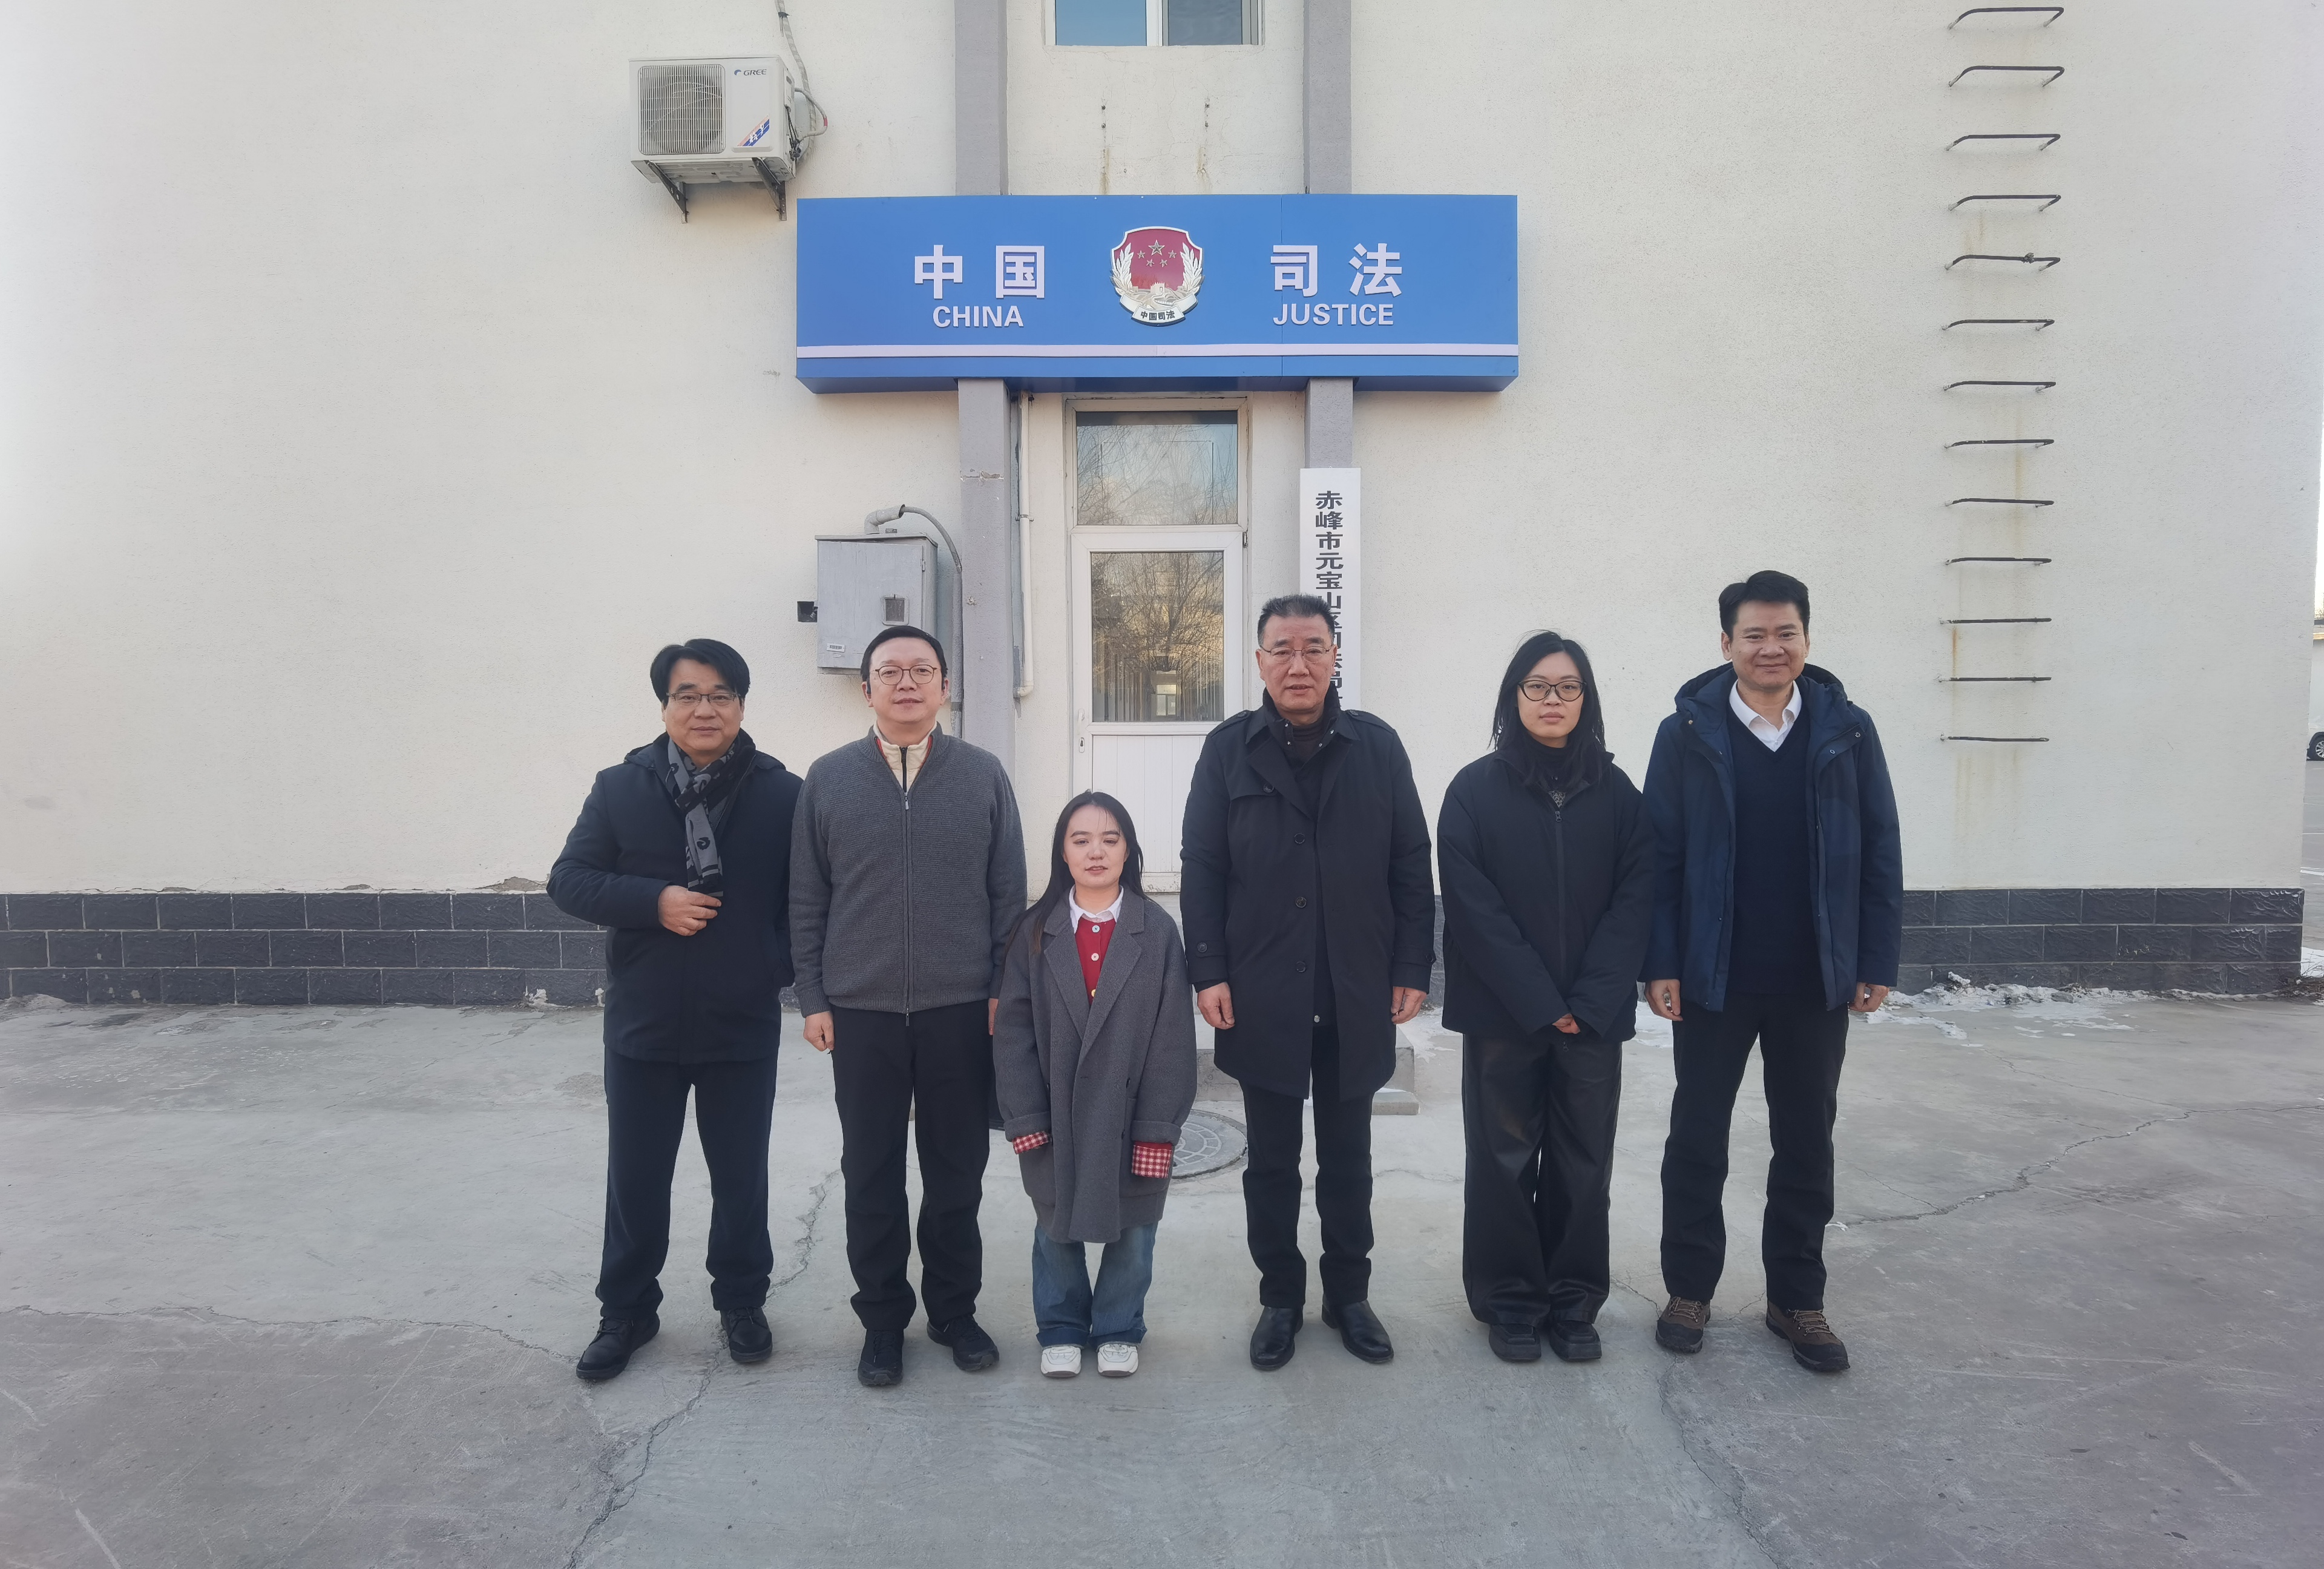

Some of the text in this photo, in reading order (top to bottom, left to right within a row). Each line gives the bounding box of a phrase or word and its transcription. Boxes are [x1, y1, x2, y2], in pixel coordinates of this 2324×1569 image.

[914, 243, 1402, 300] 中国 司法
[933, 303, 1394, 327] CHINA JUSTICE
[1140, 311, 1175, 321] 中国司法
